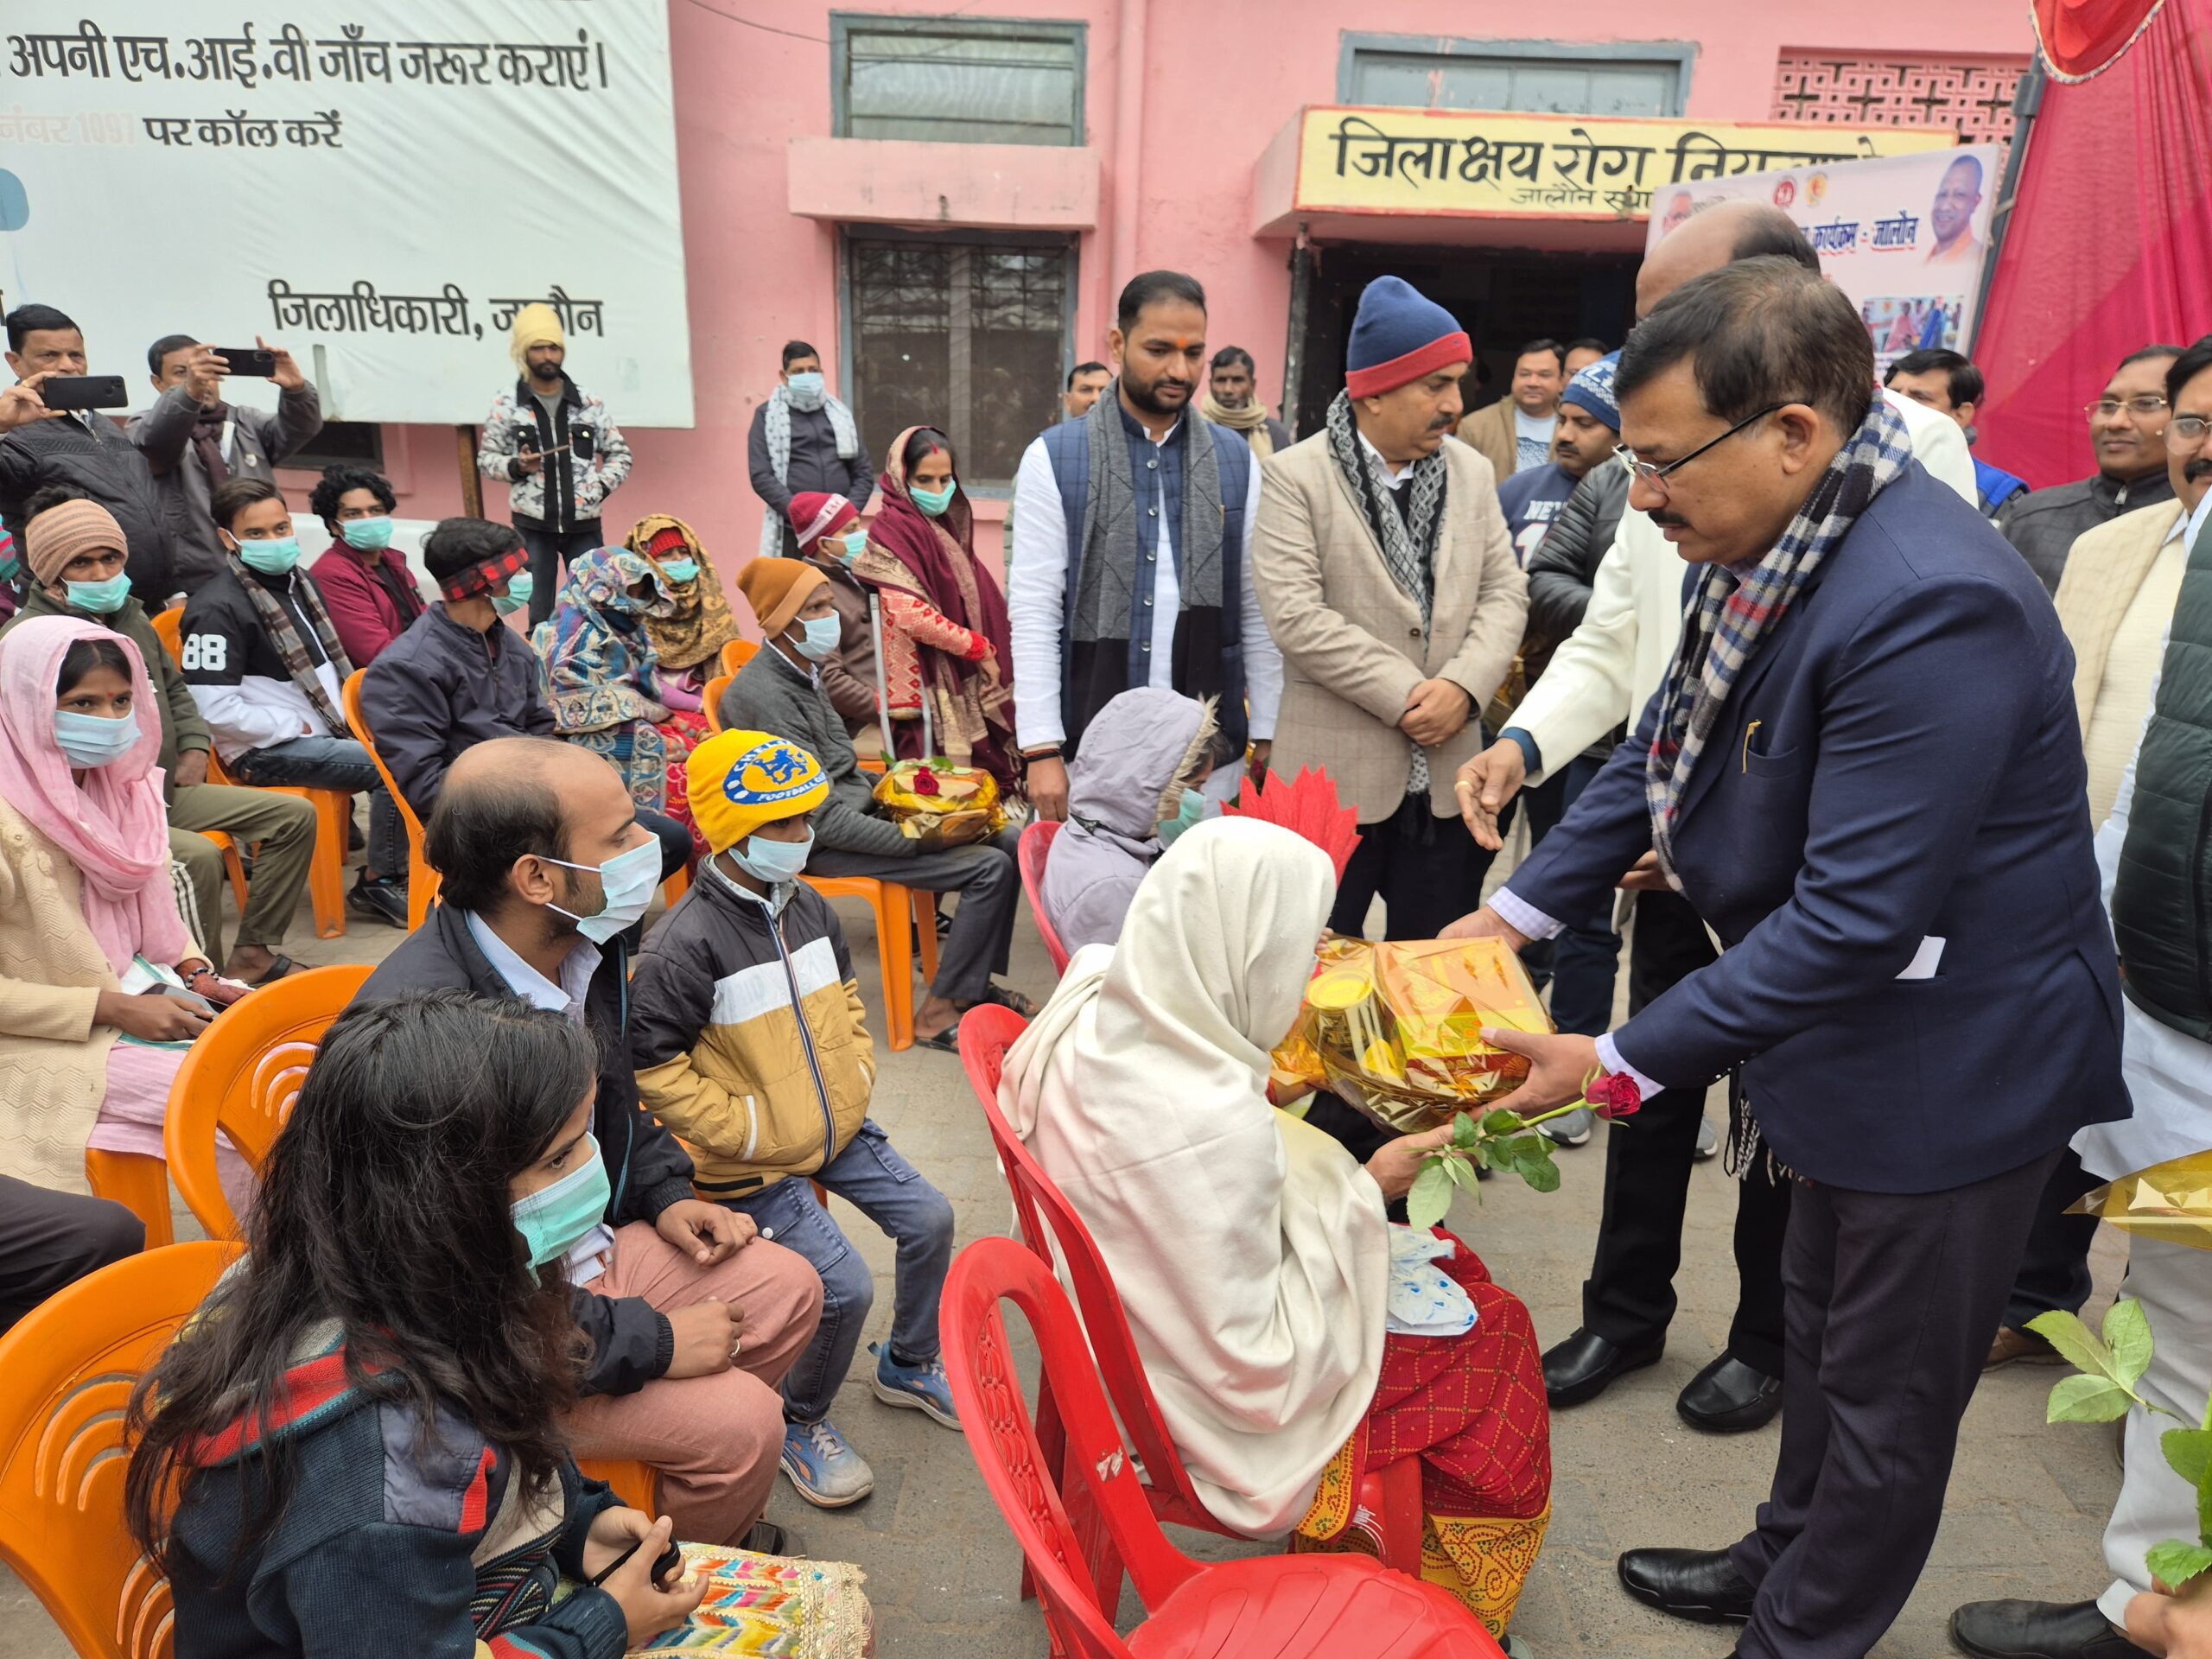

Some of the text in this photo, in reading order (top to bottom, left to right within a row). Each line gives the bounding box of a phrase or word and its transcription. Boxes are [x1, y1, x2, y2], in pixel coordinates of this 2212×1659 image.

[7, 19, 110, 78] अपनी
[113, 22, 311, 88] एच.आई.वी
[315, 23, 391, 83] जाँच
[396, 41, 492, 85] जरूर
[143, 118, 192, 147] पर
[195, 109, 279, 148] कॉल
[283, 109, 343, 148] करें
[1329, 116, 1457, 188] जिला
[1459, 136, 1544, 190] क्षय
[1553, 128, 1656, 190] रोग
[268, 278, 484, 340] जिलाधिकारी,
[181, 633, 226, 671] 88
[757, 781, 817, 802] FOOTBALL
